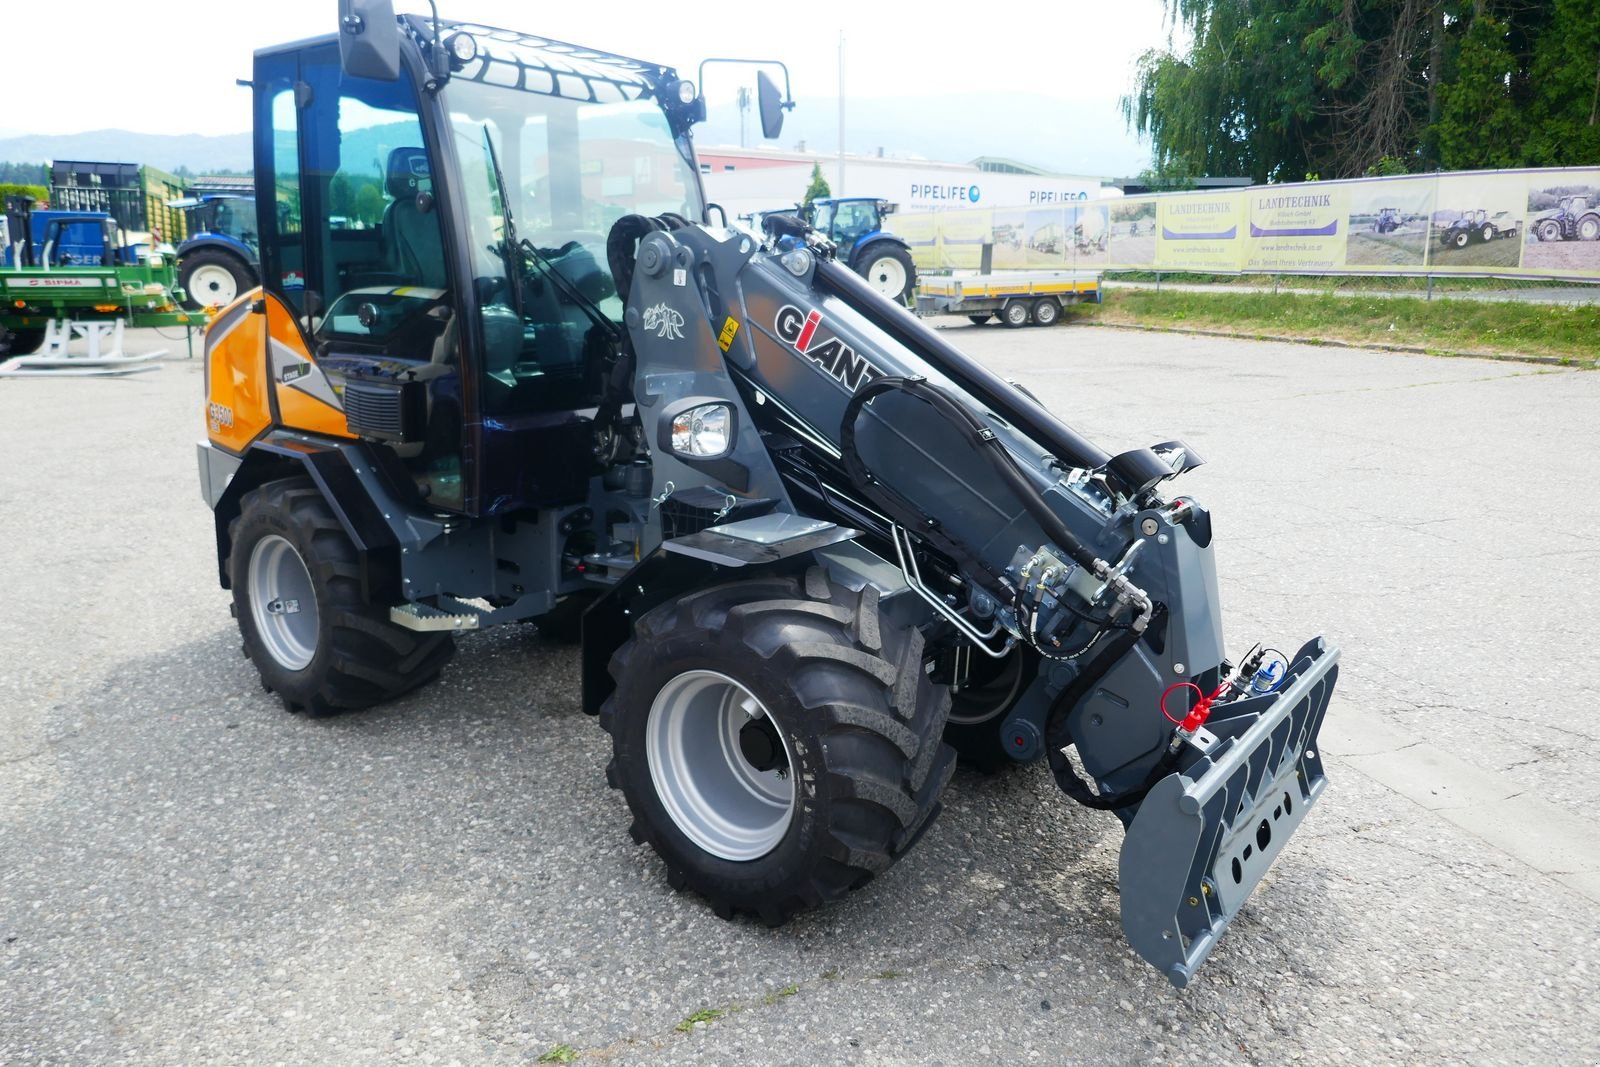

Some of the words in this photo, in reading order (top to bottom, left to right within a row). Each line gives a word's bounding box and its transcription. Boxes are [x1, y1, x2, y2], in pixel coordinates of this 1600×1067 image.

[911, 184, 967, 200] PIPELIFE
[1169, 202, 1231, 215] LANDTECHNIK
[1258, 195, 1331, 210] LANDTECHNIK
[209, 402, 233, 427] G3500
